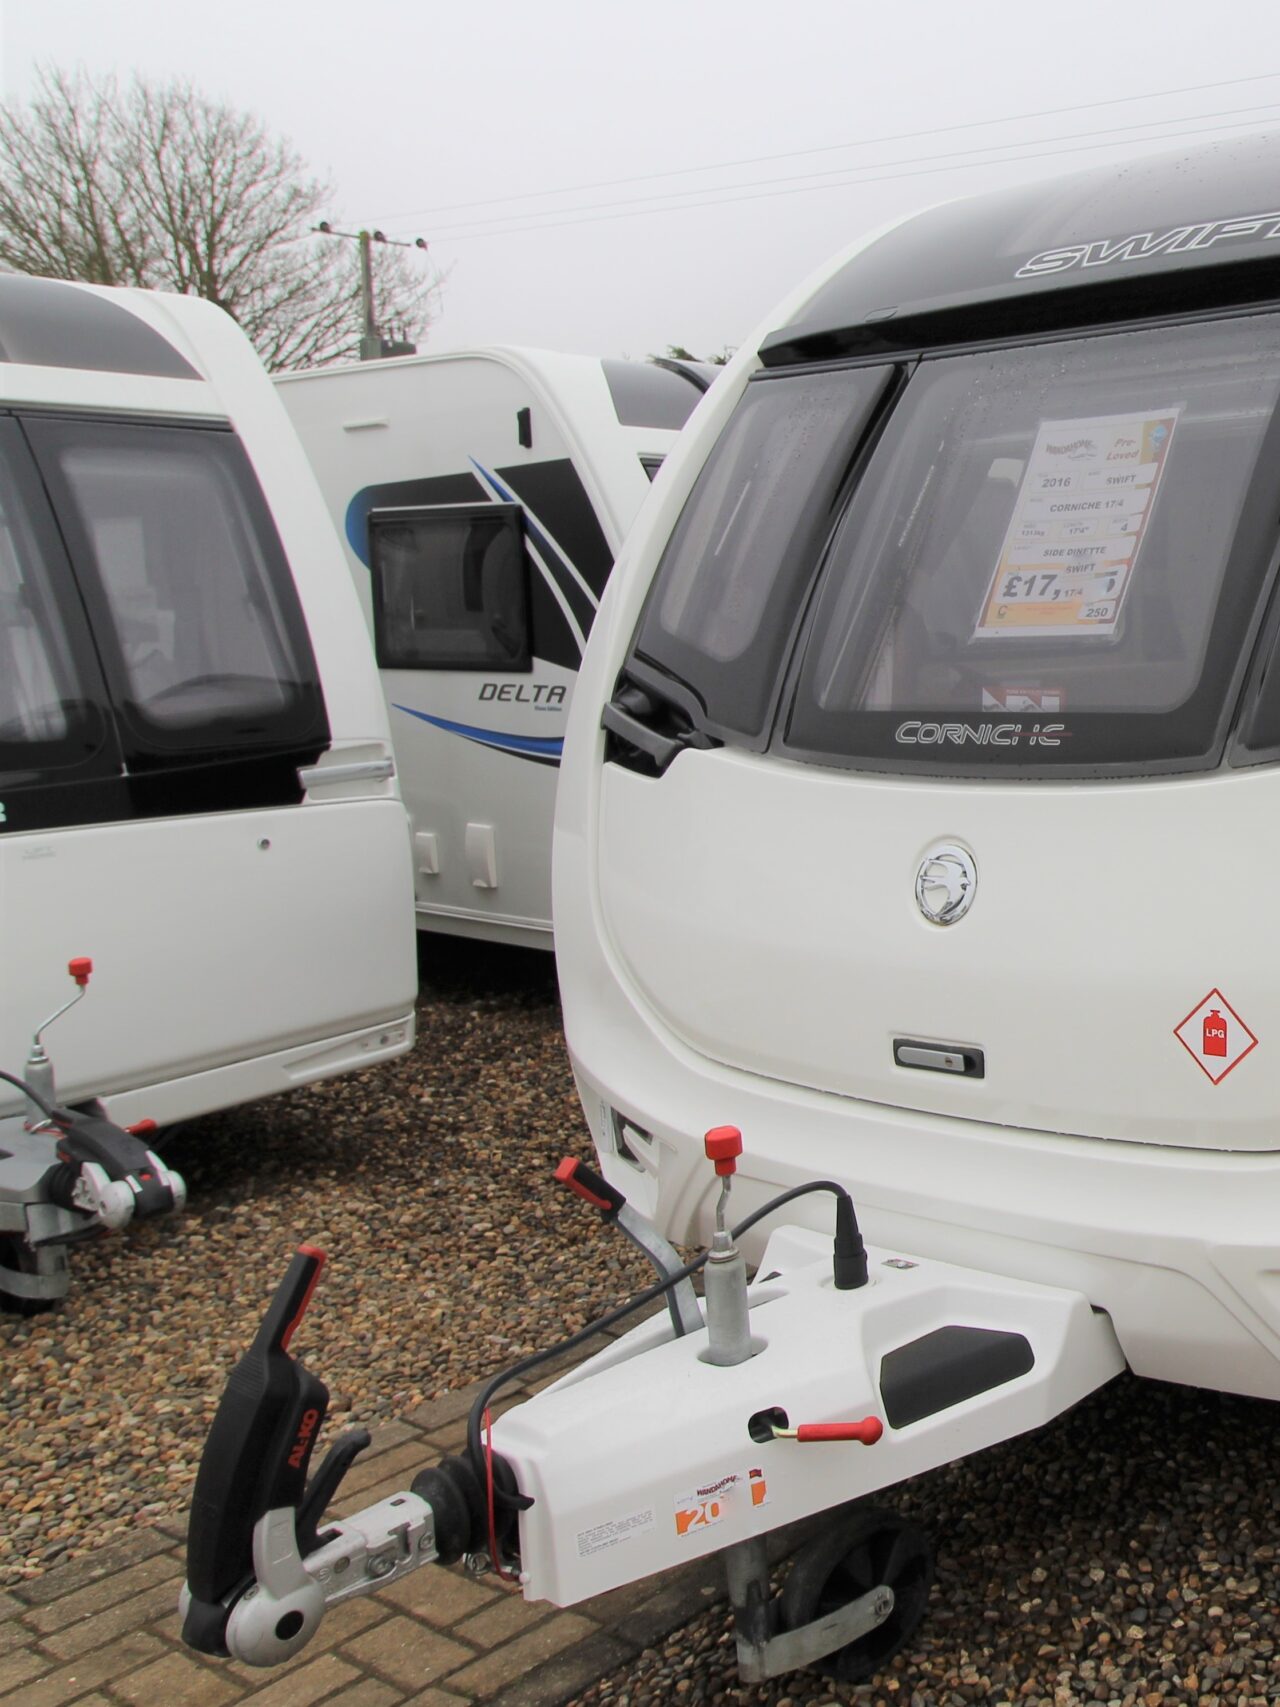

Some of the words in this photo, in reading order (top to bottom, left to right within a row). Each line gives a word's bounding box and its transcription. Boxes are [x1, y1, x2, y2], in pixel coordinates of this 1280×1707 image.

[1106, 450, 1139, 461] Loved
[1042, 478, 1072, 489] 2016
[1106, 474, 1137, 486] SWIFT
[1050, 502, 1101, 513] CORNICHE
[1120, 522, 1129, 532] 4
[1043, 546, 1065, 557] SIDE
[1066, 546, 1107, 557] DINETTE
[1066, 563, 1096, 574] SWIFT
[1086, 607, 1109, 618] 250
[478, 683, 567, 704] DELTA
[895, 721, 1073, 746] CORNICHE
[1206, 1028, 1225, 1039] LPG
